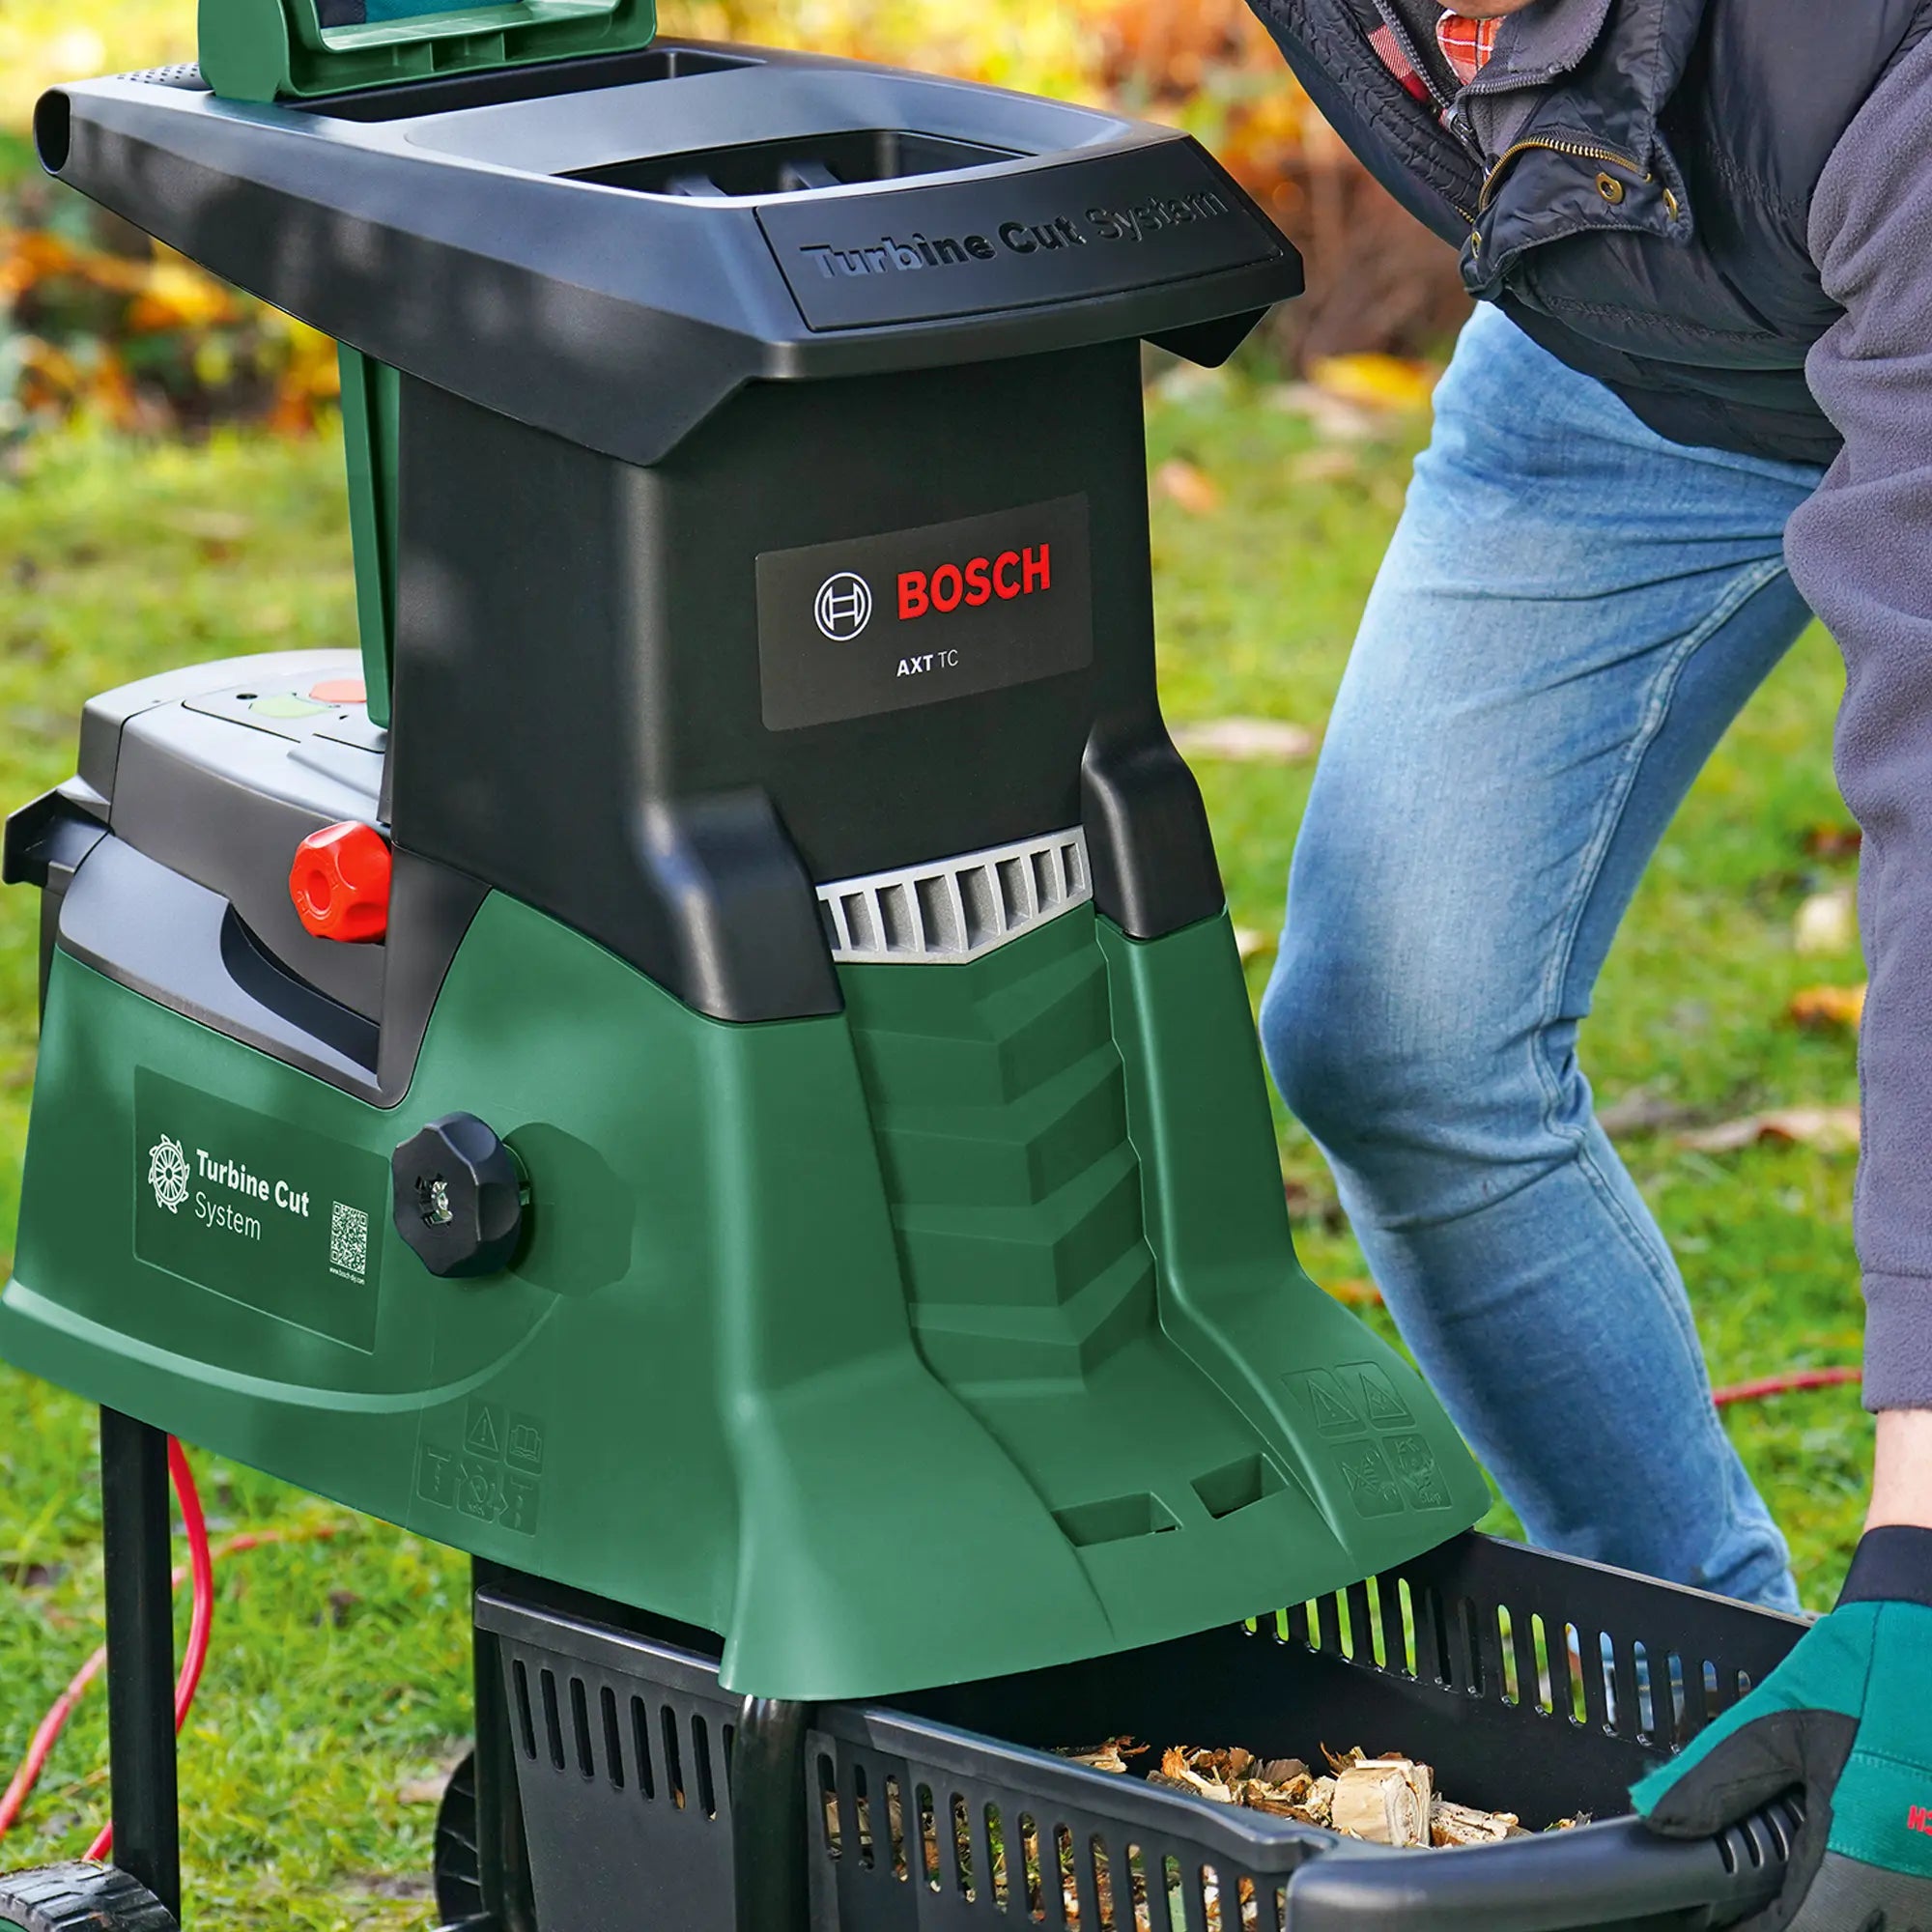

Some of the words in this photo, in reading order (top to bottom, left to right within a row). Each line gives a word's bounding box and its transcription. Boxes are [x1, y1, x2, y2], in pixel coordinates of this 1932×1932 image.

[800, 233, 996, 279] Turbine
[997, 213, 1088, 255] Cut
[1084, 192, 1230, 242] System
[896, 542, 1051, 620] BOSCH
[896, 653, 934, 677] AXT
[938, 648, 959, 668] TC
[194, 1190, 262, 1241] System
[196, 1148, 270, 1202] Turbine
[274, 1179, 309, 1217] Cut
